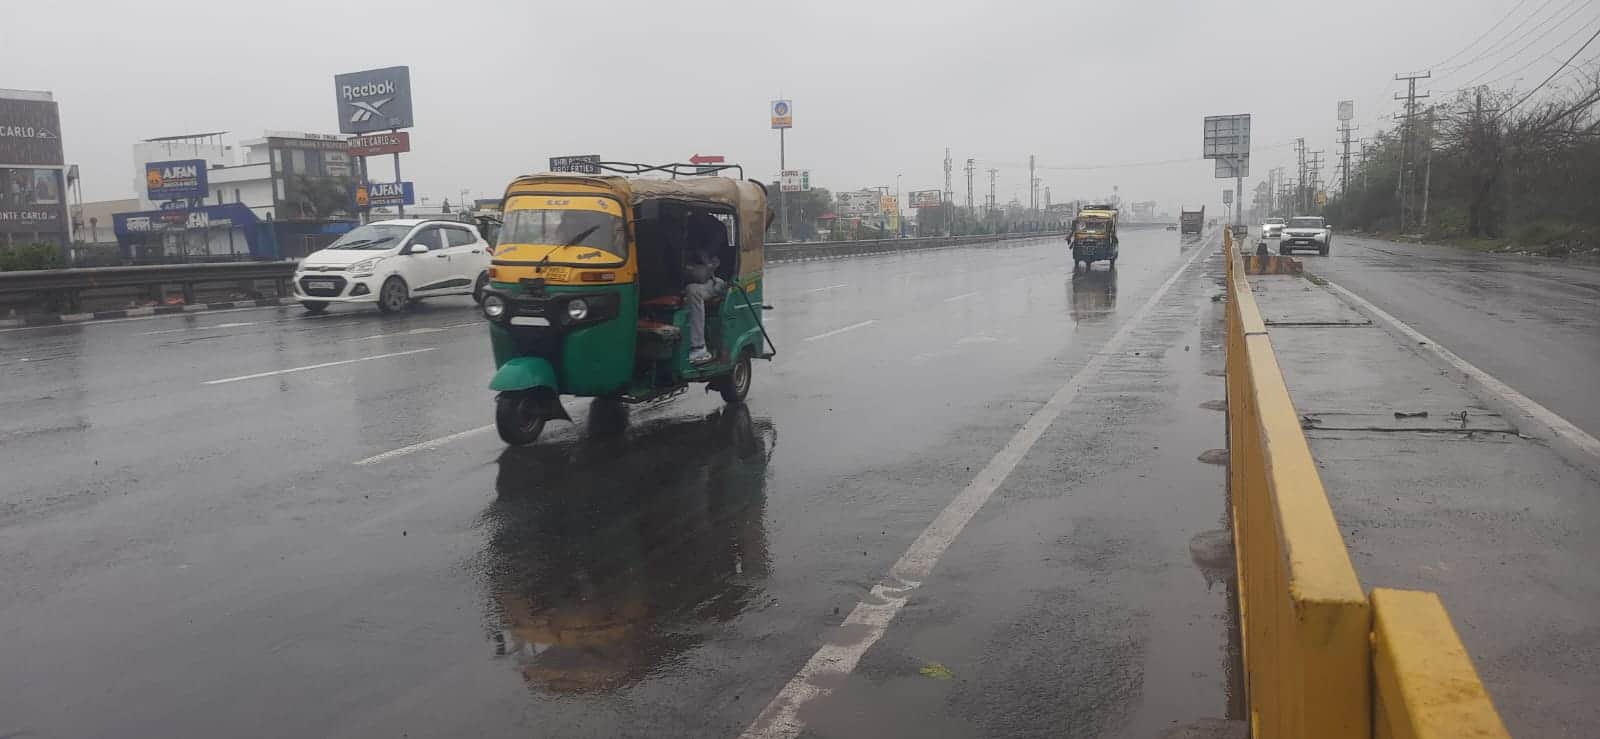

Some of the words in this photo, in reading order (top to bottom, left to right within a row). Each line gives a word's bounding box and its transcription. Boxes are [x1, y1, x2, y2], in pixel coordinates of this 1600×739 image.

[343, 80, 394, 100] Reebok
[0, 126, 34, 137] CARLO
[347, 136, 368, 148] MONTE
[369, 135, 389, 146] CARLO
[163, 165, 197, 179] AJFAN
[370, 183, 403, 197] AJFAN
